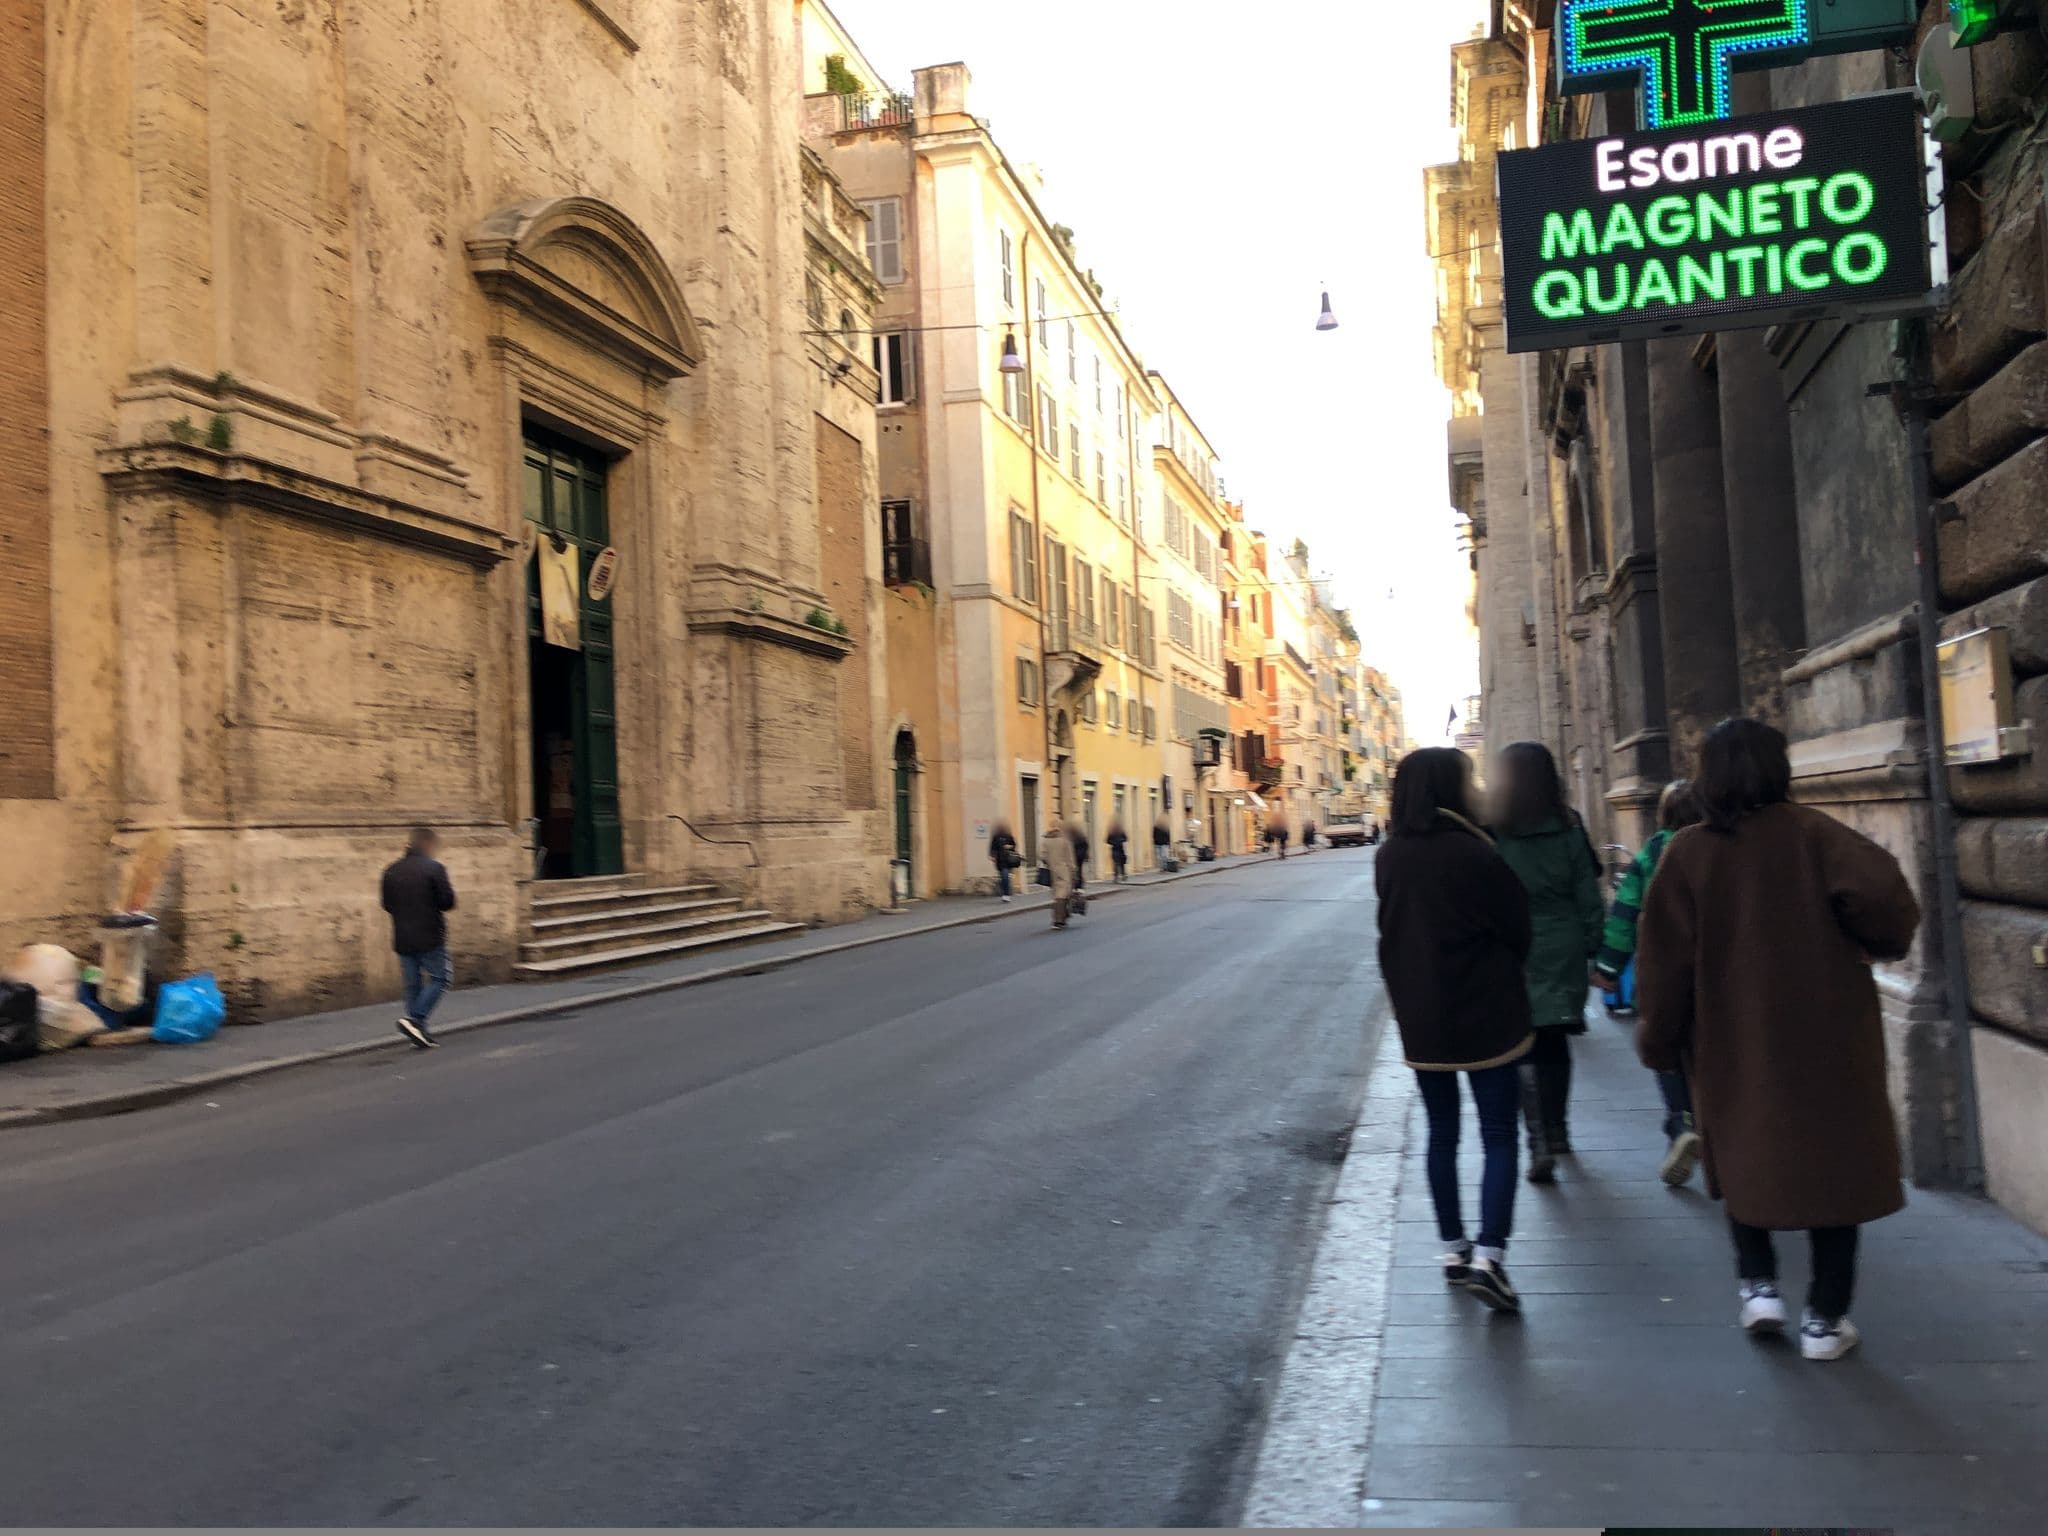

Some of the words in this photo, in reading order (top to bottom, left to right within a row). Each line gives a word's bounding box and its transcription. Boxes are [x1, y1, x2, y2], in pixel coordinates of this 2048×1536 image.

[1596, 127, 1804, 192] Esame
[1541, 172, 1874, 260] MAGNETO
[1532, 233, 1888, 319] QUANTICO
